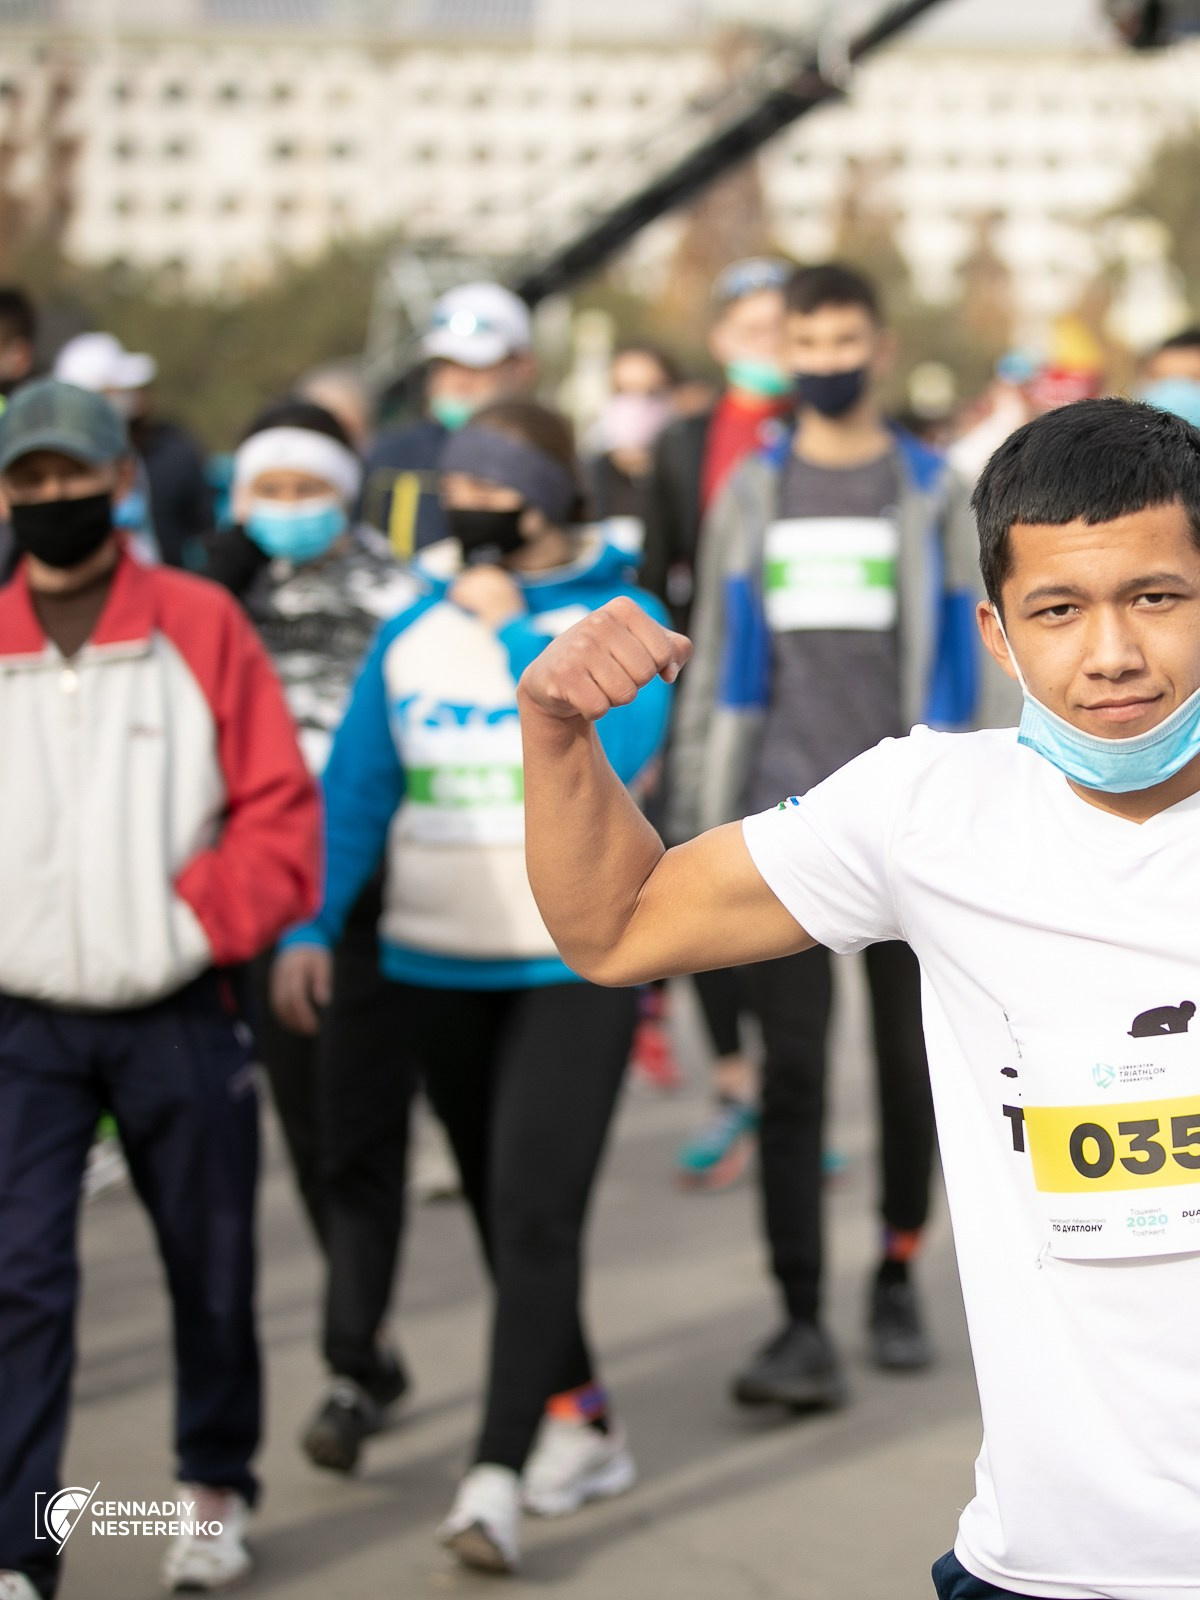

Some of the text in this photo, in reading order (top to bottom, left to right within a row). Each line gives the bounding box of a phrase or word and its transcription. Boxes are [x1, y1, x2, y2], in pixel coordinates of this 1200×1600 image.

[1119, 1067, 1166, 1077] TRIATHLON
[1126, 1214, 1169, 1228] 2020
[1052, 1224, 1103, 1233] ПО ДУАТЛОНУ
[1132, 1228, 1166, 1237] Toshkent
